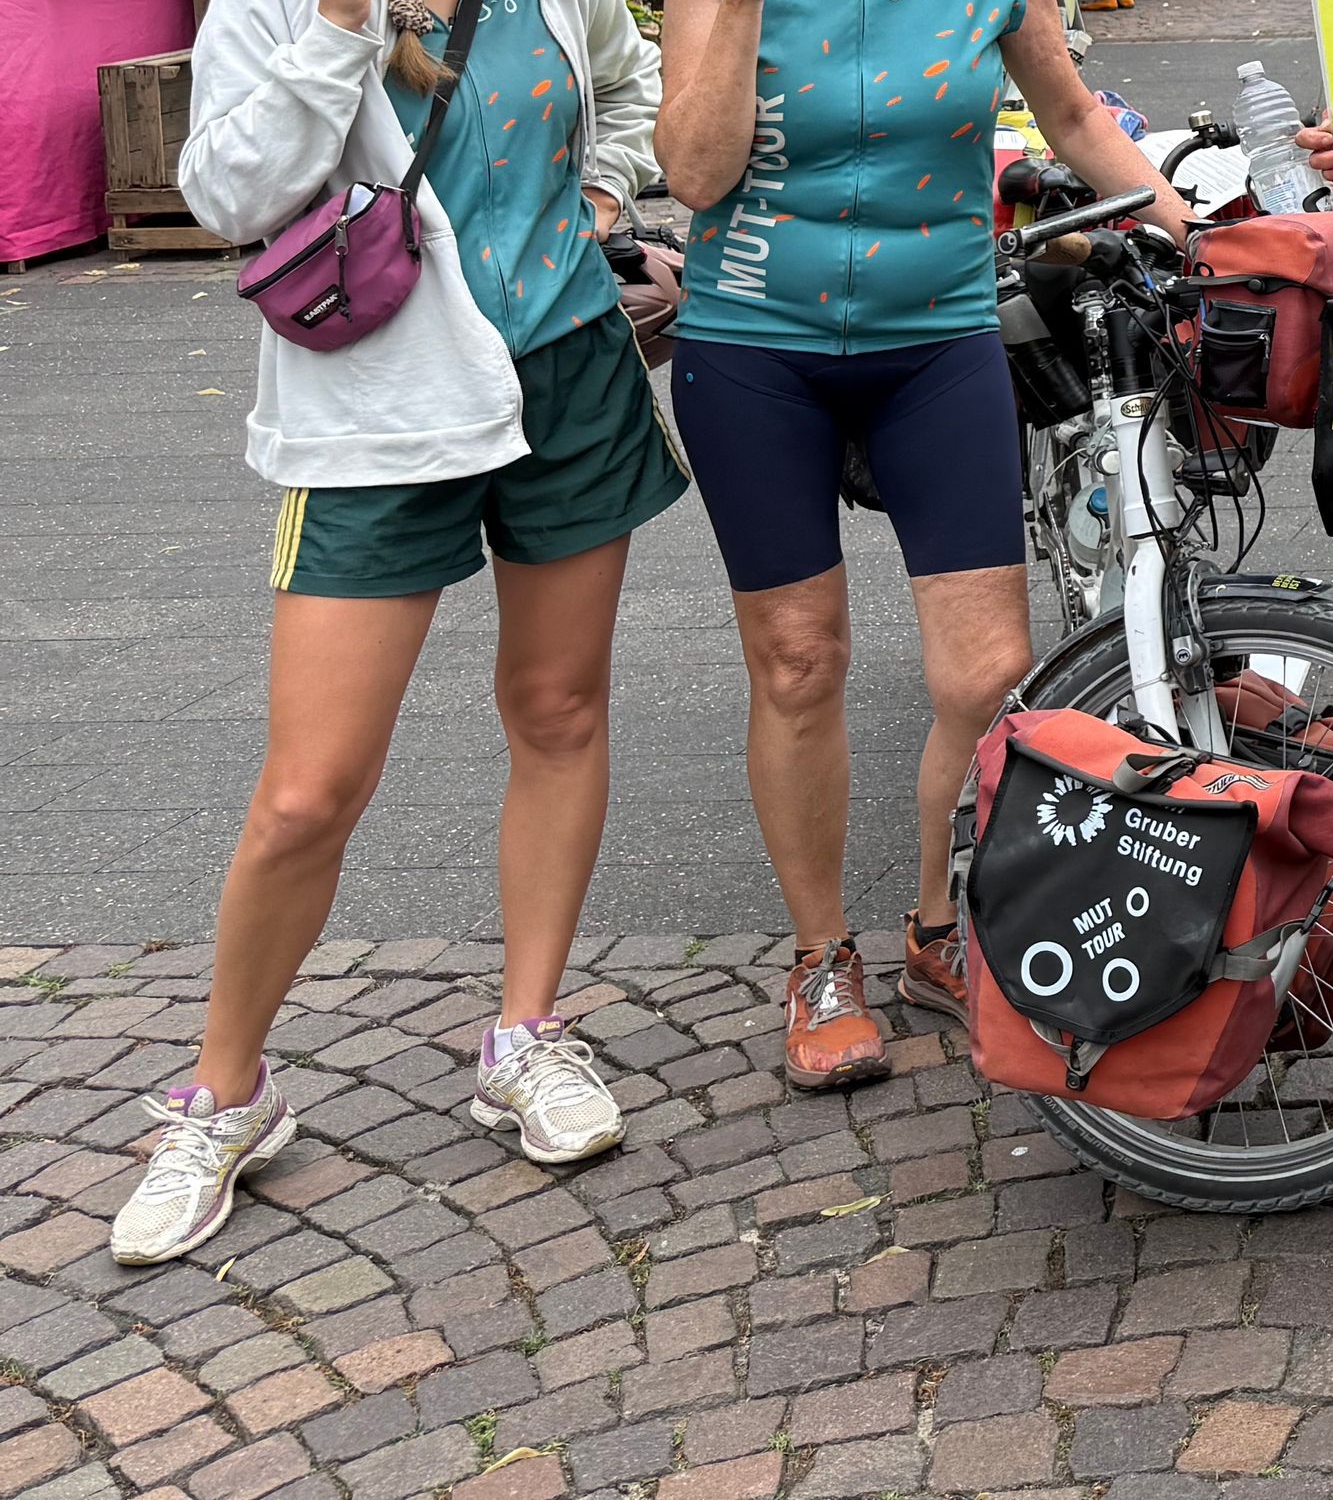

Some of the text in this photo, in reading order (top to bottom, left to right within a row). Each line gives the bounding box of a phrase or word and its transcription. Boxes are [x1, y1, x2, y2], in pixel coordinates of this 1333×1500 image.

[717, 93, 790, 299] MUT-TOUR
[304, 293, 338, 321] EASTPAK
[1125, 807, 1201, 849] Gruber
[1117, 835, 1202, 886] Stiftung
[1072, 898, 1113, 935] MUT
[1081, 922, 1125, 960] TOUR
